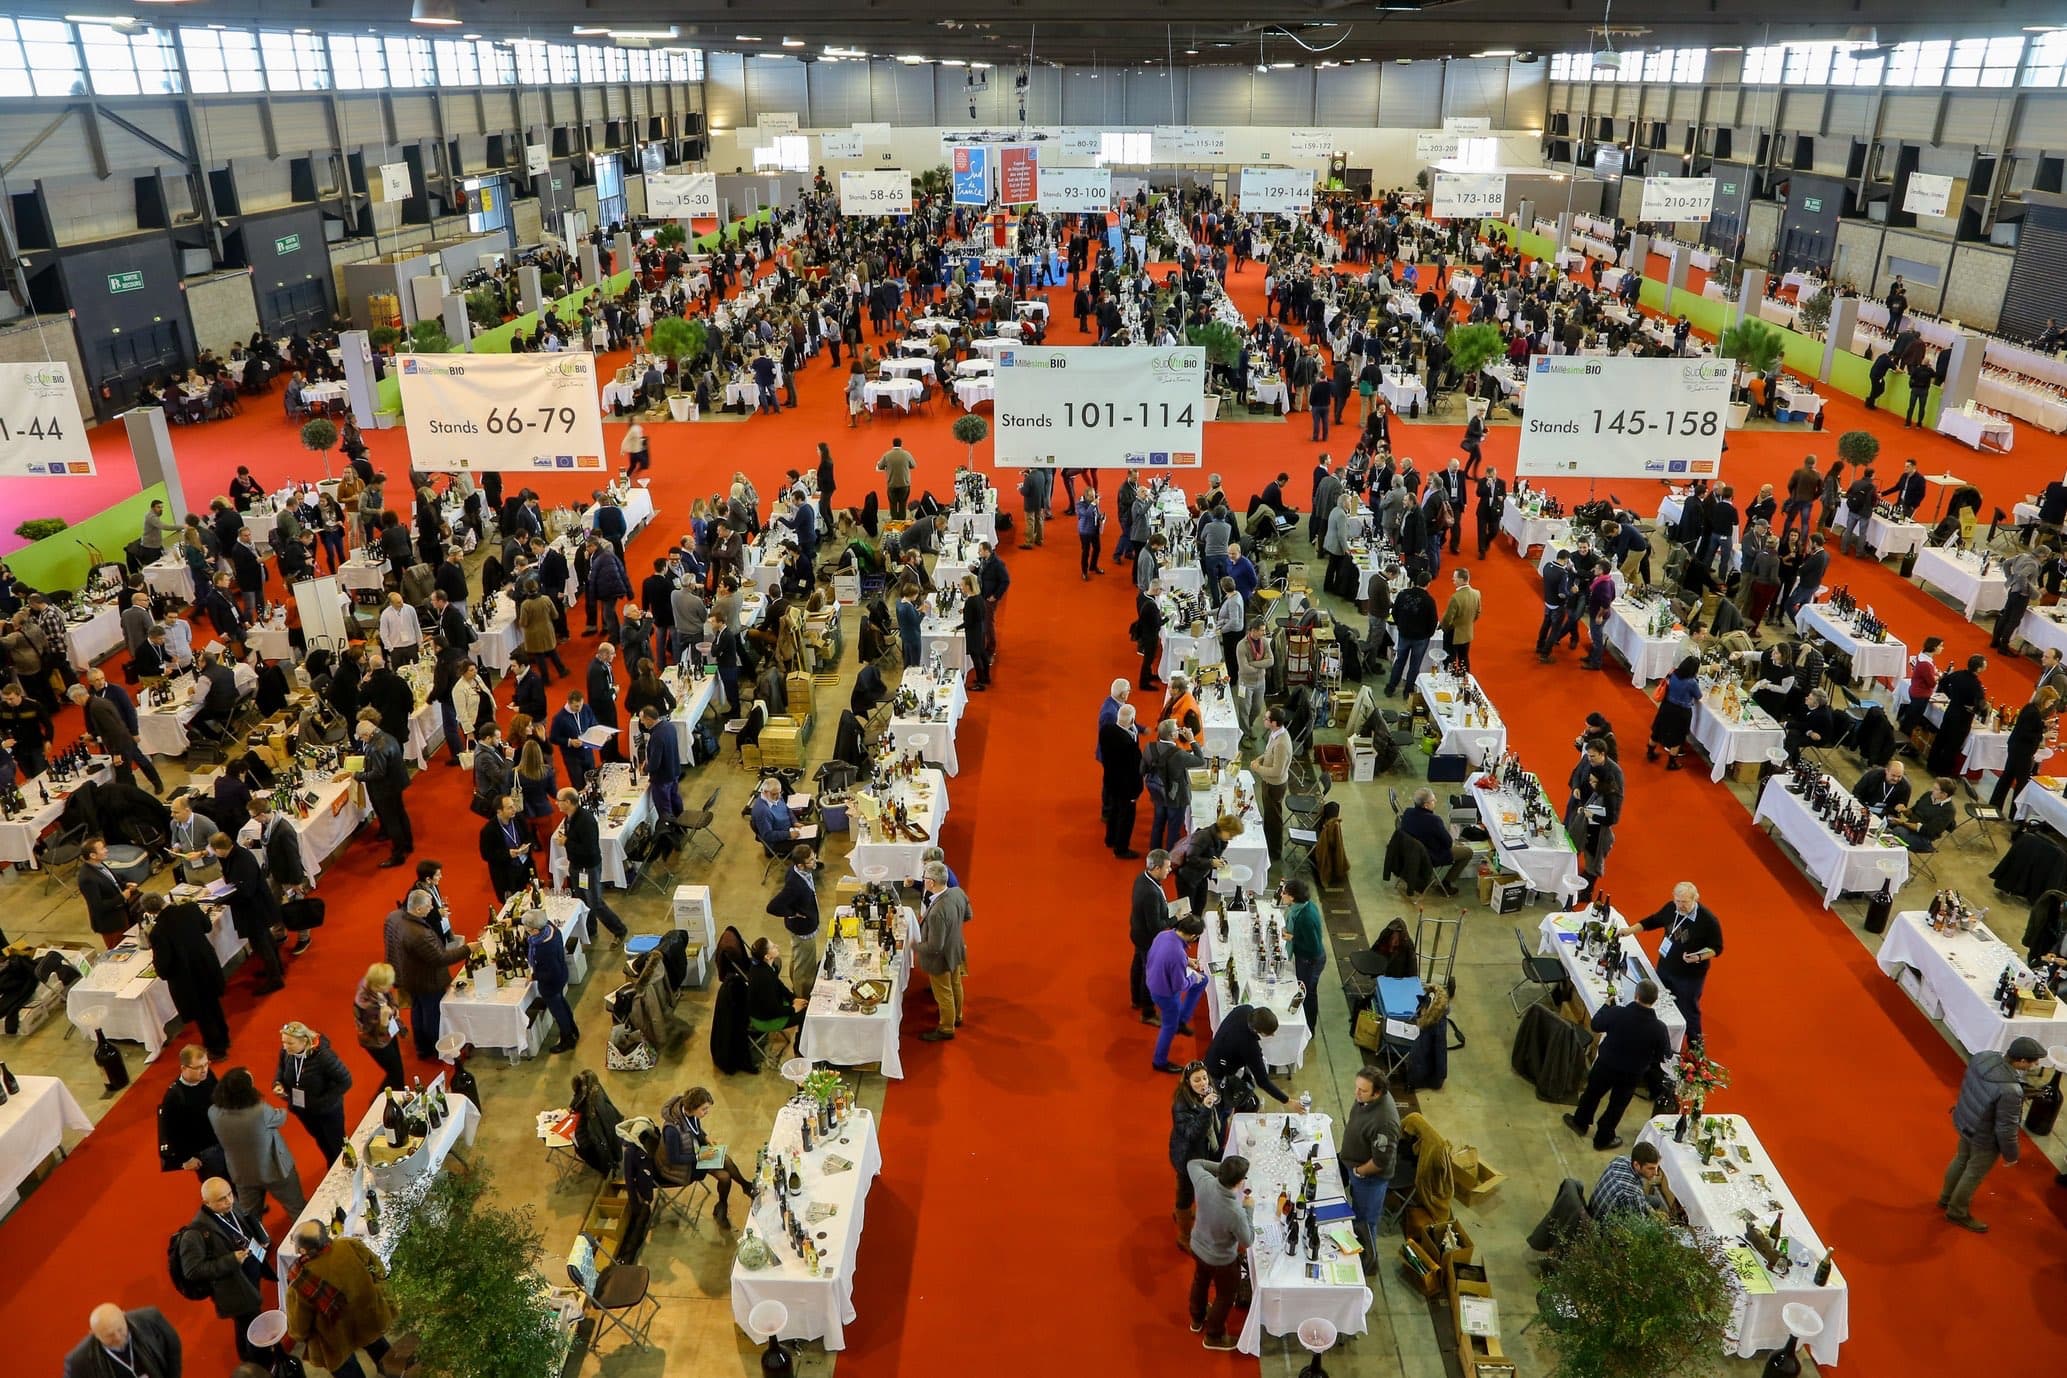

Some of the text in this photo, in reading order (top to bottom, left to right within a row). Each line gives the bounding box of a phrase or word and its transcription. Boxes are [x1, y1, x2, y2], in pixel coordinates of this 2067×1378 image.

[964, 160, 983, 180] Sud
[870, 189, 903, 200] 58-65
[956, 182, 984, 197] France
[1064, 187, 1106, 198] 93-100
[1264, 187, 1309, 197] 129-144
[677, 194, 709, 205] 15-30
[1457, 193, 1502, 204] 173-188
[1664, 197, 1711, 207] 210-217
[429, 407, 576, 434] Stands 66-79
[1002, 402, 1195, 428] Stands 101-114
[1529, 409, 1718, 436] Stands 145-158
